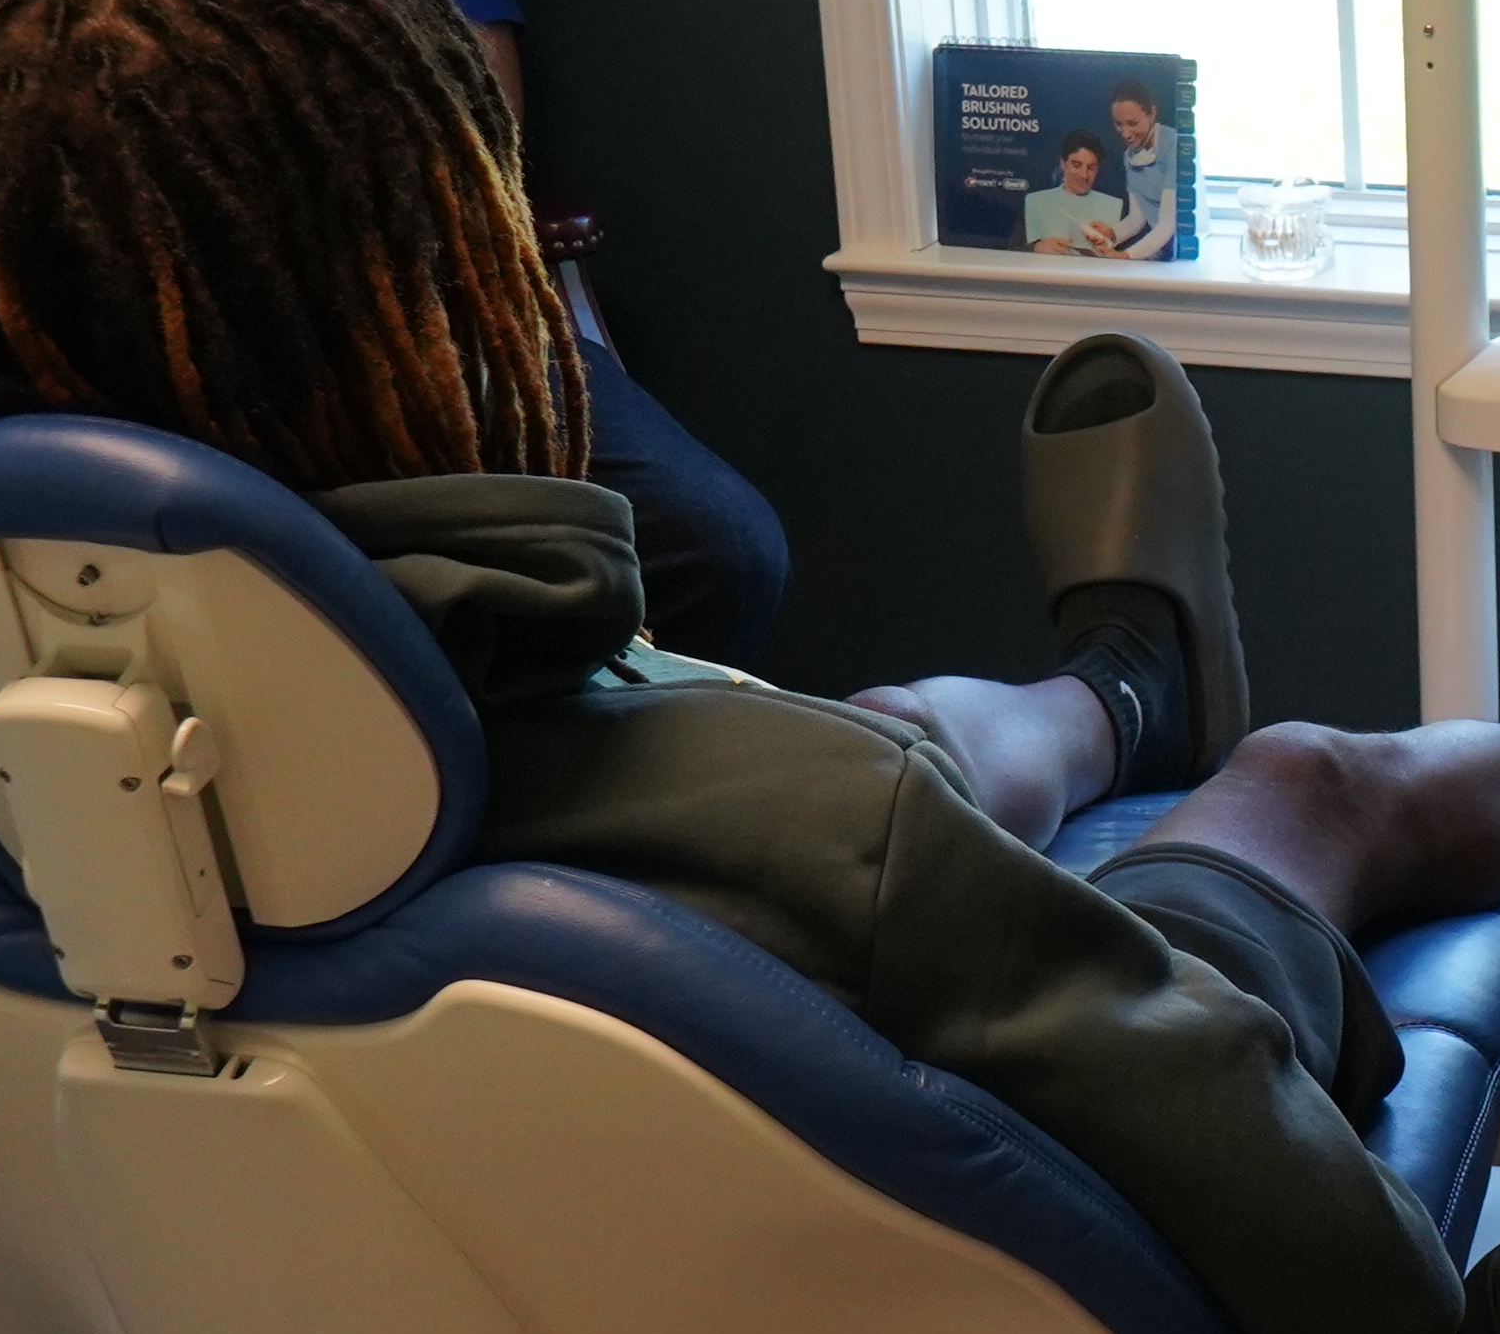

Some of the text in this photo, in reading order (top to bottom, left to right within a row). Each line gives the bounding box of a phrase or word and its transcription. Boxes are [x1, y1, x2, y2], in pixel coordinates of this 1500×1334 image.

[961, 83, 1028, 100] TAILORED
[961, 99, 1032, 116] BRUSHING
[961, 116, 1041, 133] SOLUTIONS
